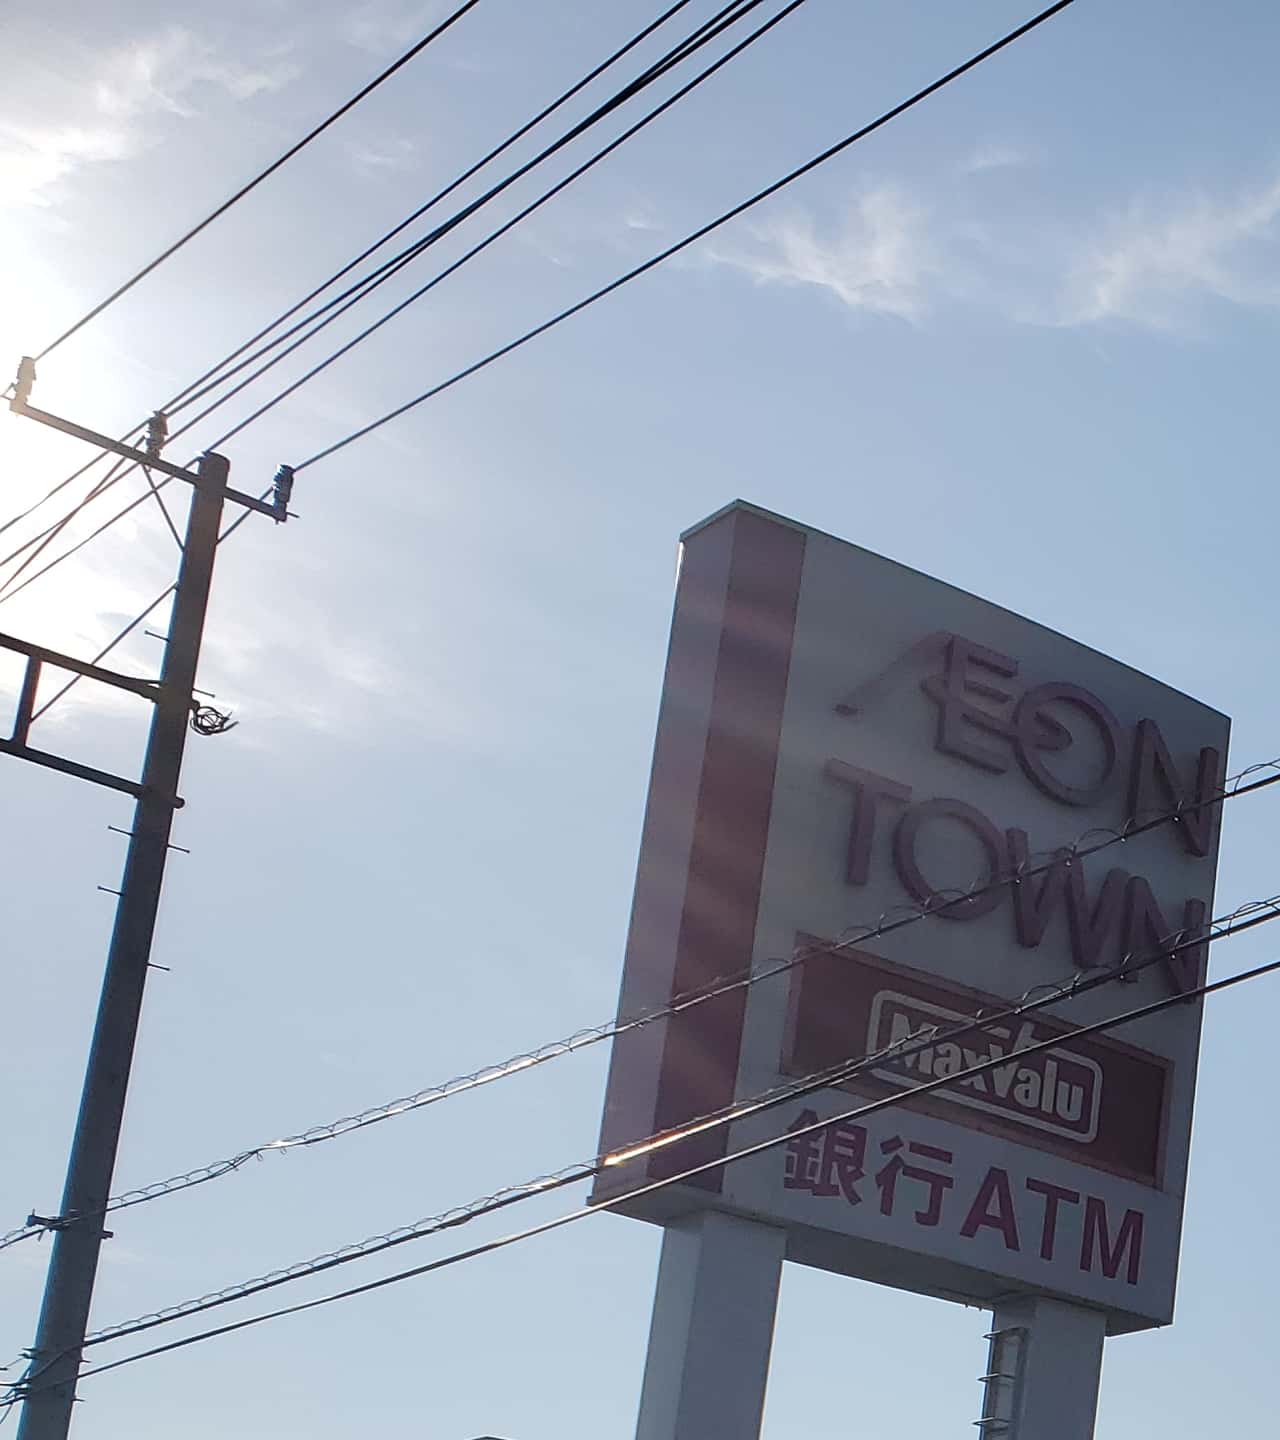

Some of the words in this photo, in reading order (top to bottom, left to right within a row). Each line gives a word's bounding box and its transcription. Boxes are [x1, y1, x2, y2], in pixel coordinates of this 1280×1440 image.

[824, 757, 1207, 1000] TOWN
[889, 1012, 1085, 1124] MaxValu
[782, 1106, 1146, 1287] 銀行ATM
